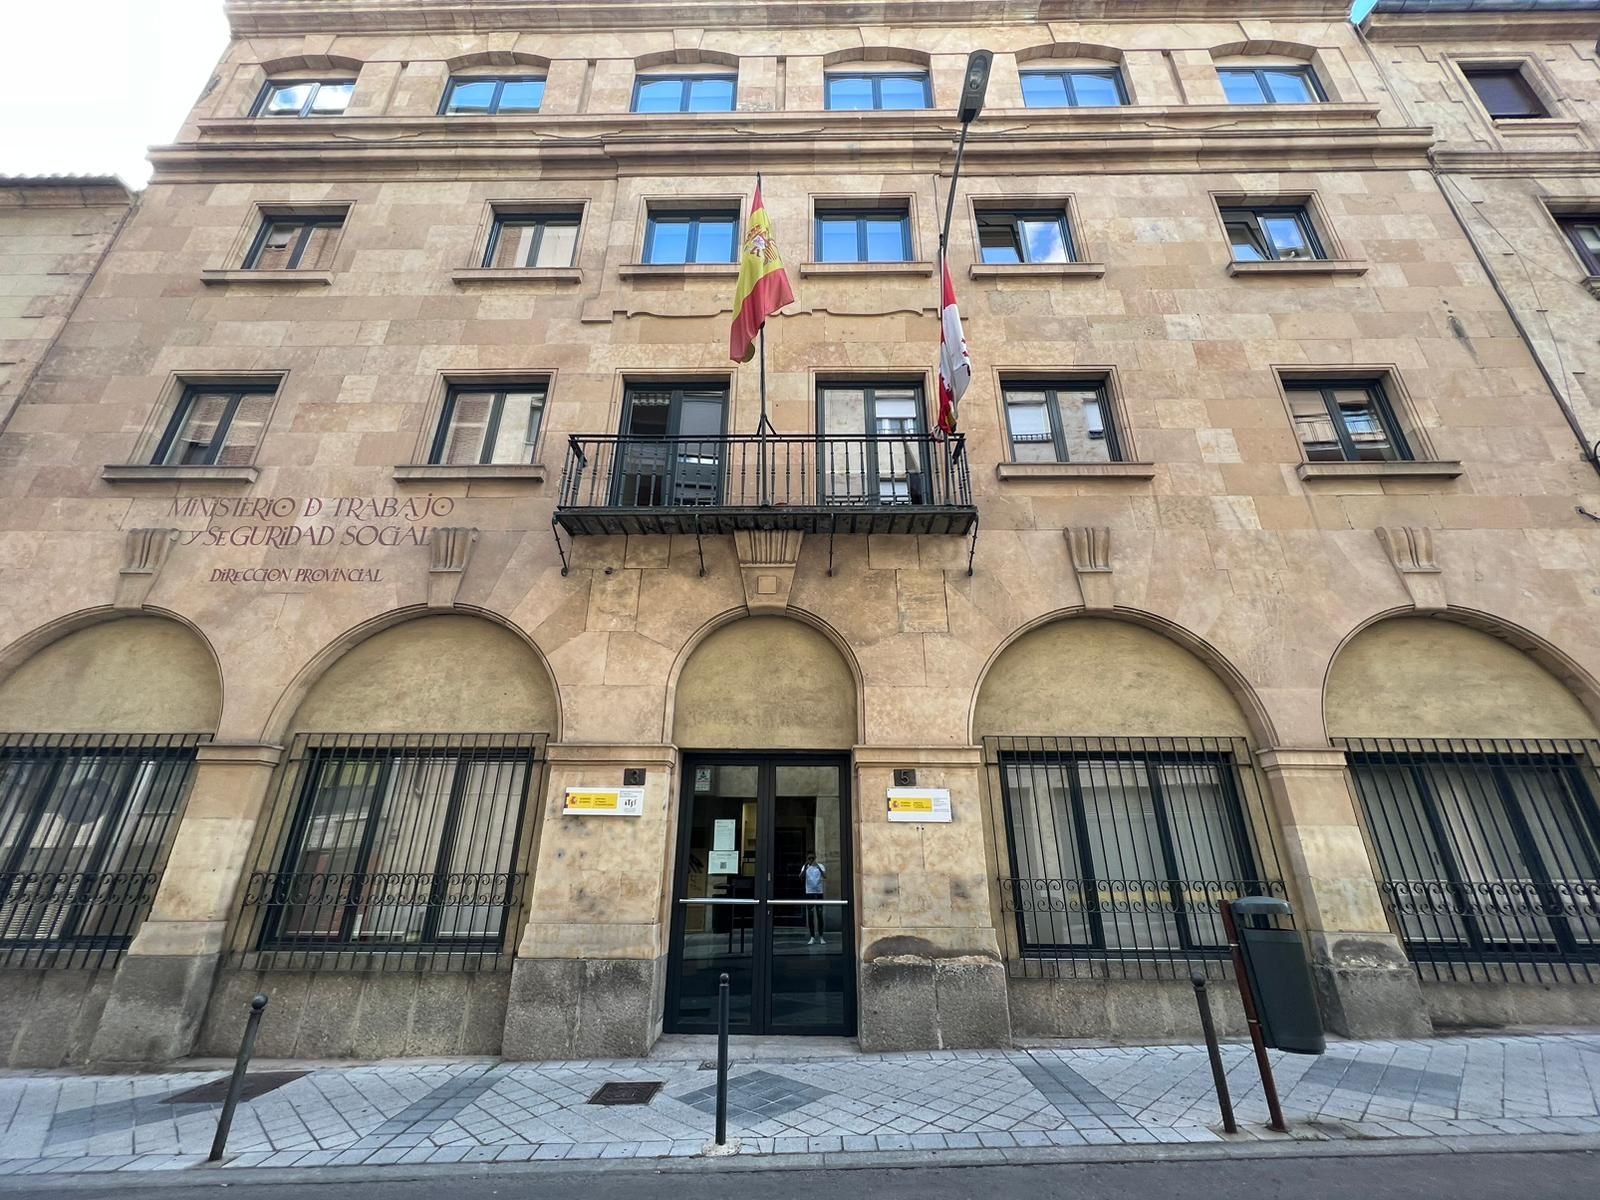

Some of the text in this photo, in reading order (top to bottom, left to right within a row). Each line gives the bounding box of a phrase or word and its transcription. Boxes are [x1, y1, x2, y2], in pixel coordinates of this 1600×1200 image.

[168, 496, 296, 521] MINISTERIO
[332, 492, 454, 522] TRABAJO
[202, 525, 335, 549] SEGURIDAD
[294, 569, 384, 585] PROVINCIAL
[900, 771, 910, 785] 5
